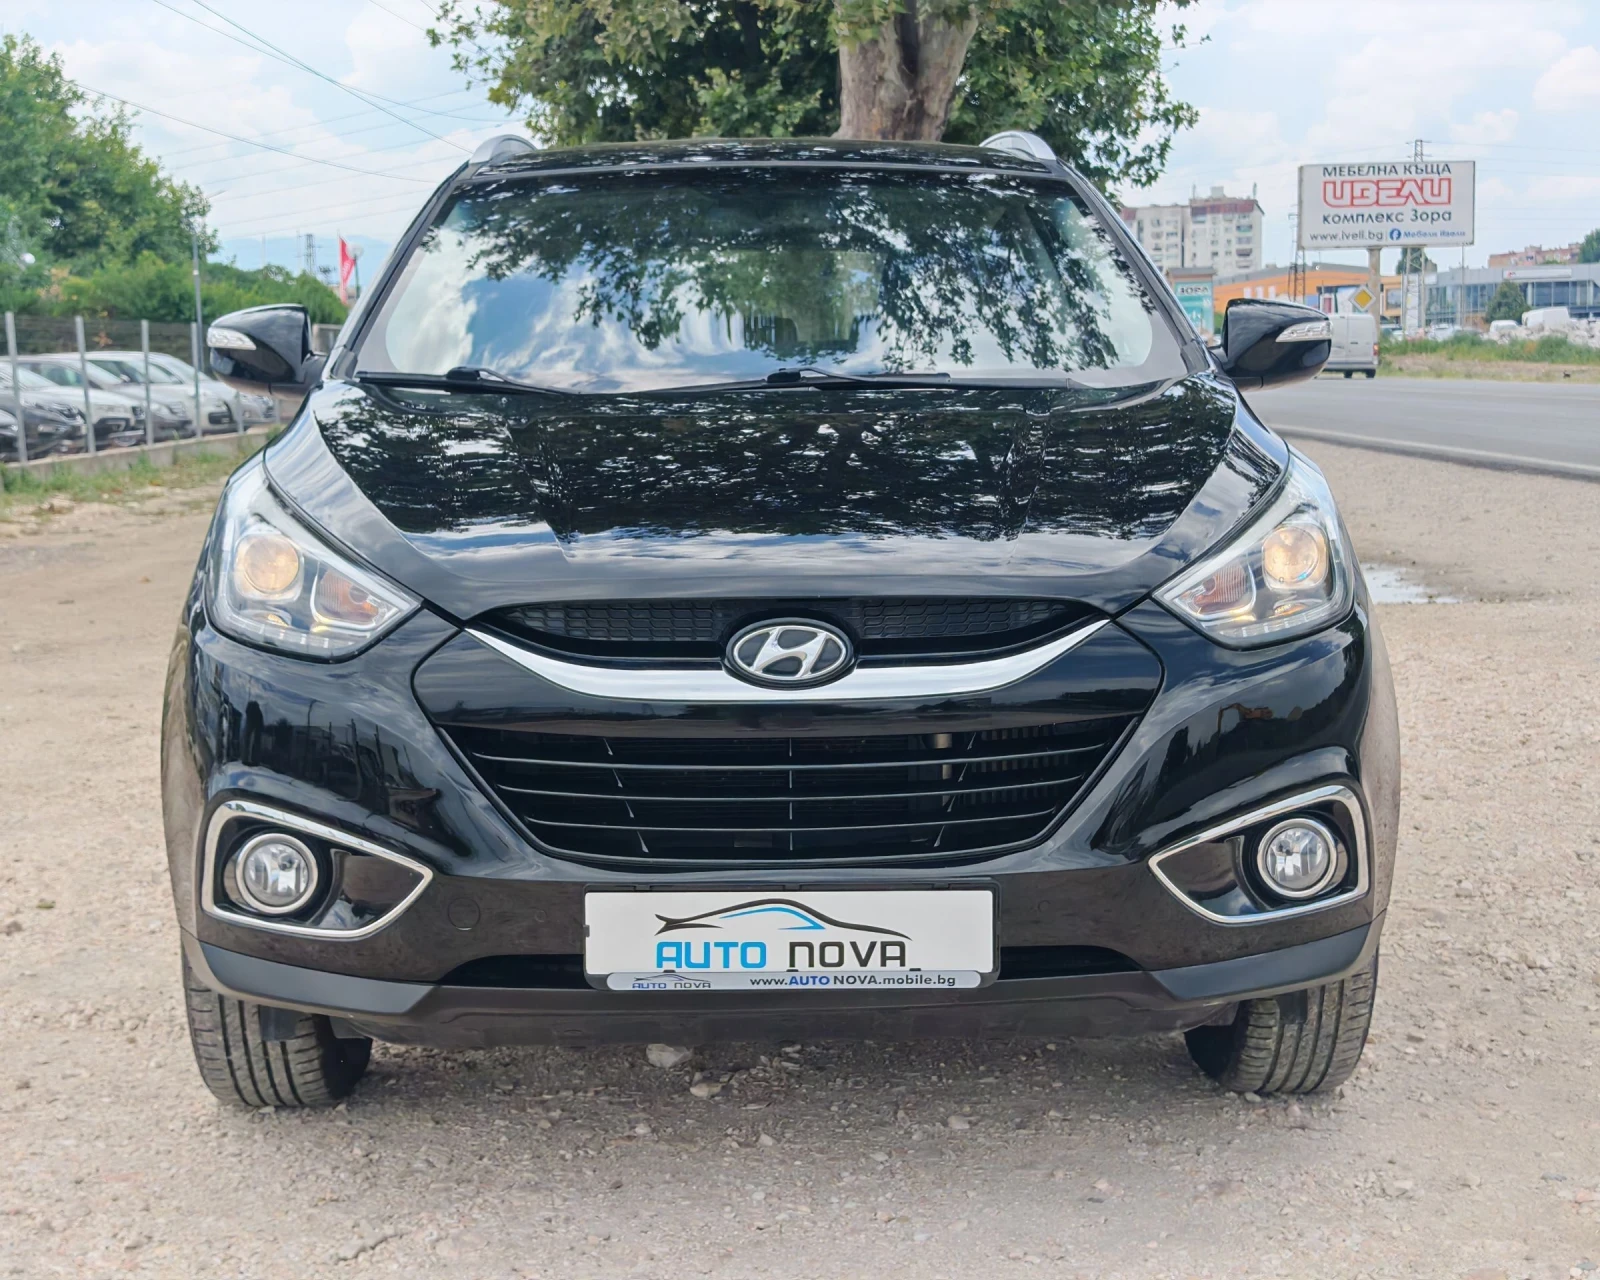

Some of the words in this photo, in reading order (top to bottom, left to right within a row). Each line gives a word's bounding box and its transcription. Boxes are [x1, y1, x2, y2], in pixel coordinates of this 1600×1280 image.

[1323, 165, 1398, 177] МЕБЕЛНА
[1403, 163, 1452, 176] КЪЩА
[1410, 209, 1452, 224] Зора
[656, 941, 767, 969] AUTO
[788, 941, 906, 968] NOVA
